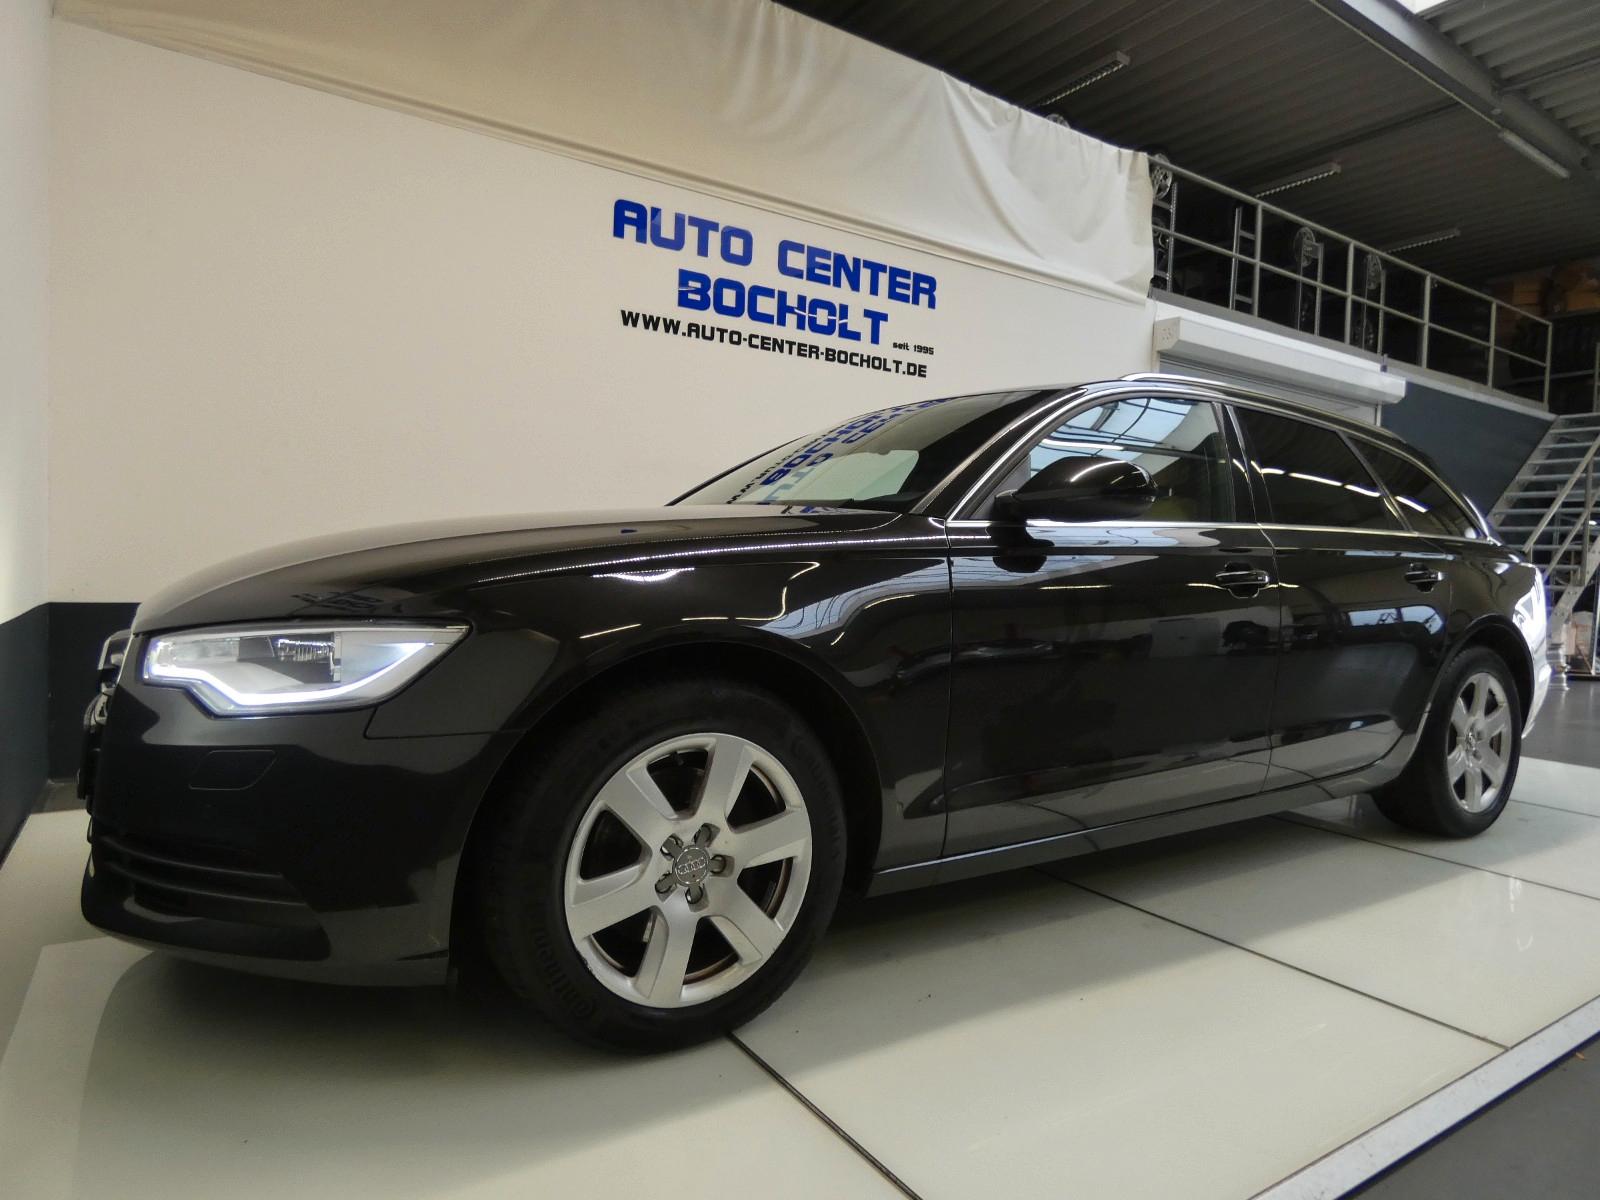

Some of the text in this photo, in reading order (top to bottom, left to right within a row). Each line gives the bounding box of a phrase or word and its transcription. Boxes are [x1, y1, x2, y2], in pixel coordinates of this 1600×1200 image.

[613, 199, 937, 309] AUTO CENTER
[678, 268, 888, 345] BOCHOLT
[621, 310, 927, 378] WWW.AUTO-CENTER-BOCHOLT.DE
[913, 344, 935, 356] 1995
